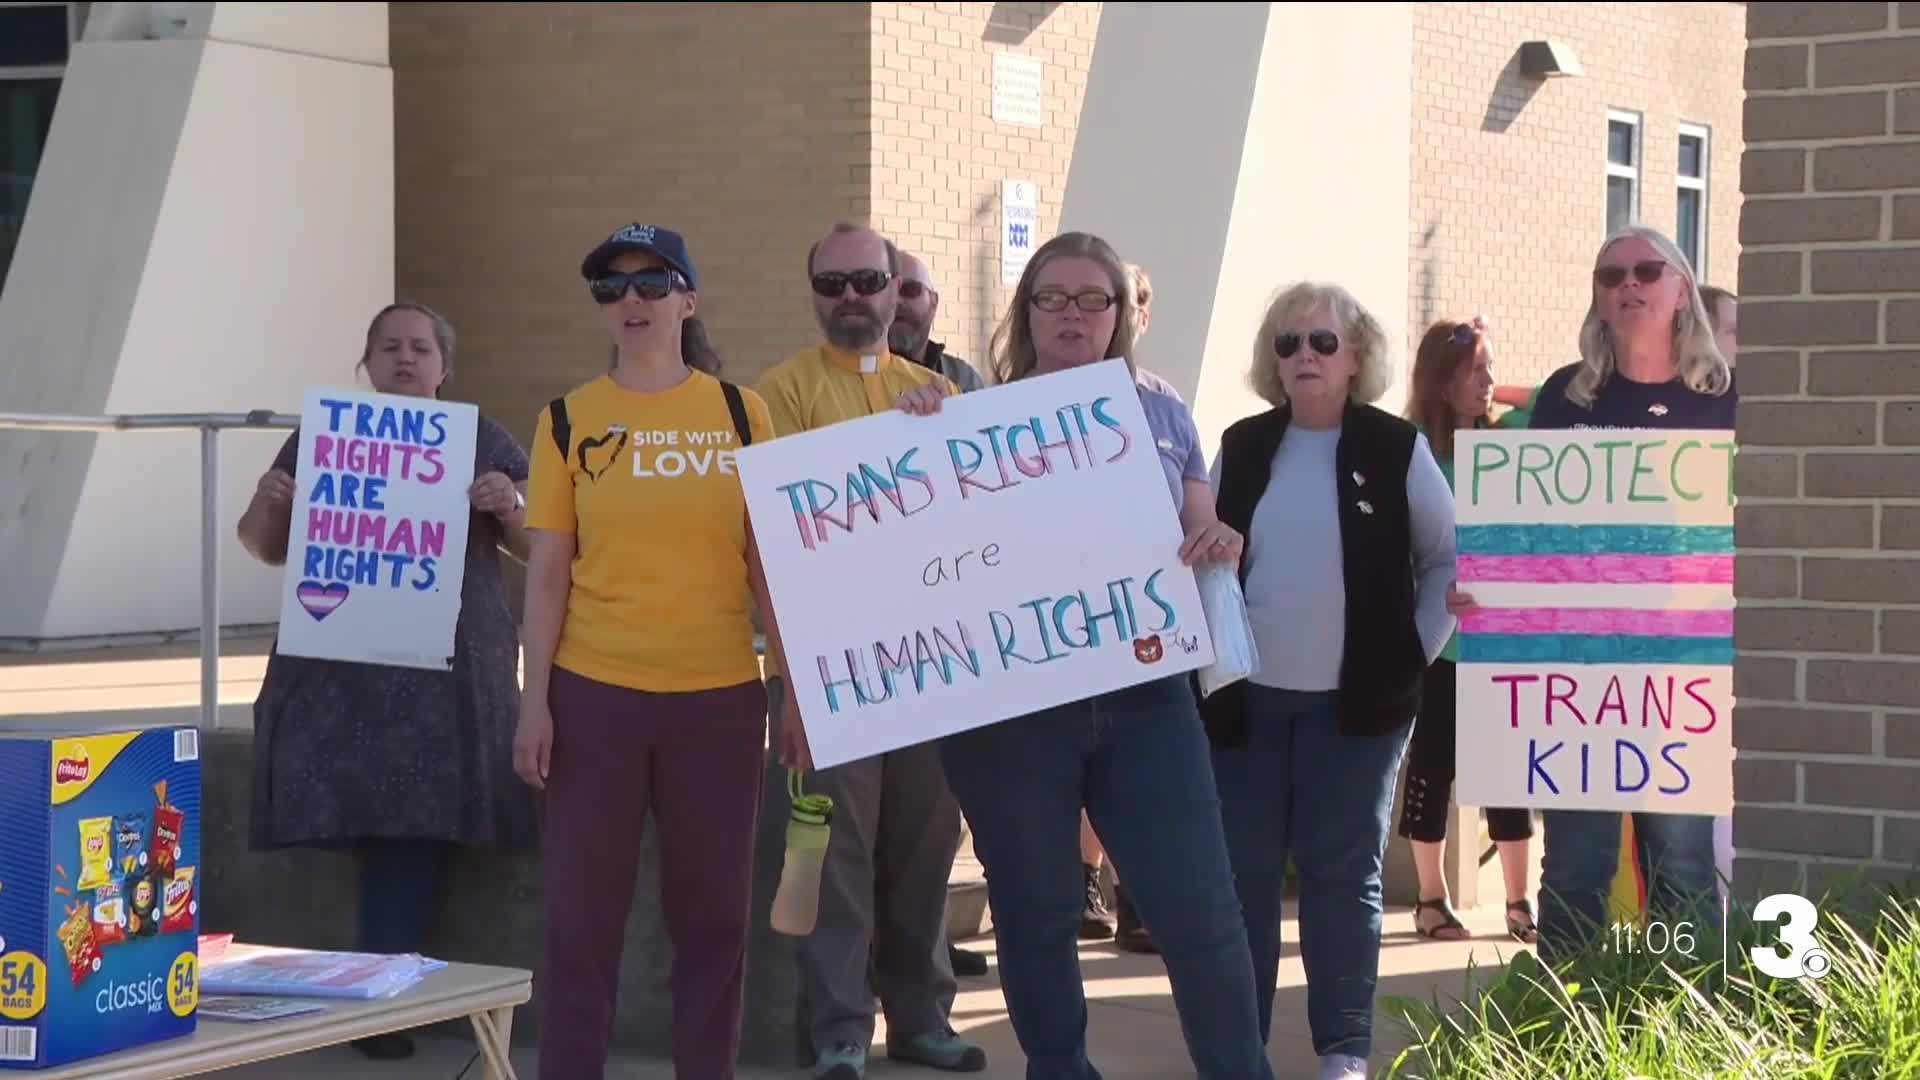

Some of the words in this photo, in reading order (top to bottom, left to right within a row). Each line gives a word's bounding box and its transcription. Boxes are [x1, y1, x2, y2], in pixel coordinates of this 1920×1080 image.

[320, 398, 448, 446] TRANS
[633, 431, 678, 446] SIDE
[314, 434, 445, 484] RIGHTS
[633, 449, 737, 477] LOVE
[776, 445, 936, 551] TRANS
[945, 397, 1131, 500] RIGHTS
[1472, 440, 1738, 506] PROTECT
[309, 472, 387, 510] ARE
[307, 508, 446, 557] HUMAN
[922, 541, 1001, 587] are
[816, 619, 981, 714] HUMAN
[988, 568, 1177, 671] RIGHTS
[1491, 673, 1717, 734] TRANS
[1527, 738, 1691, 795] KIDS
[1, 961, 36, 996] 54
[95, 971, 164, 1013] classic
[174, 961, 194, 996] 54
